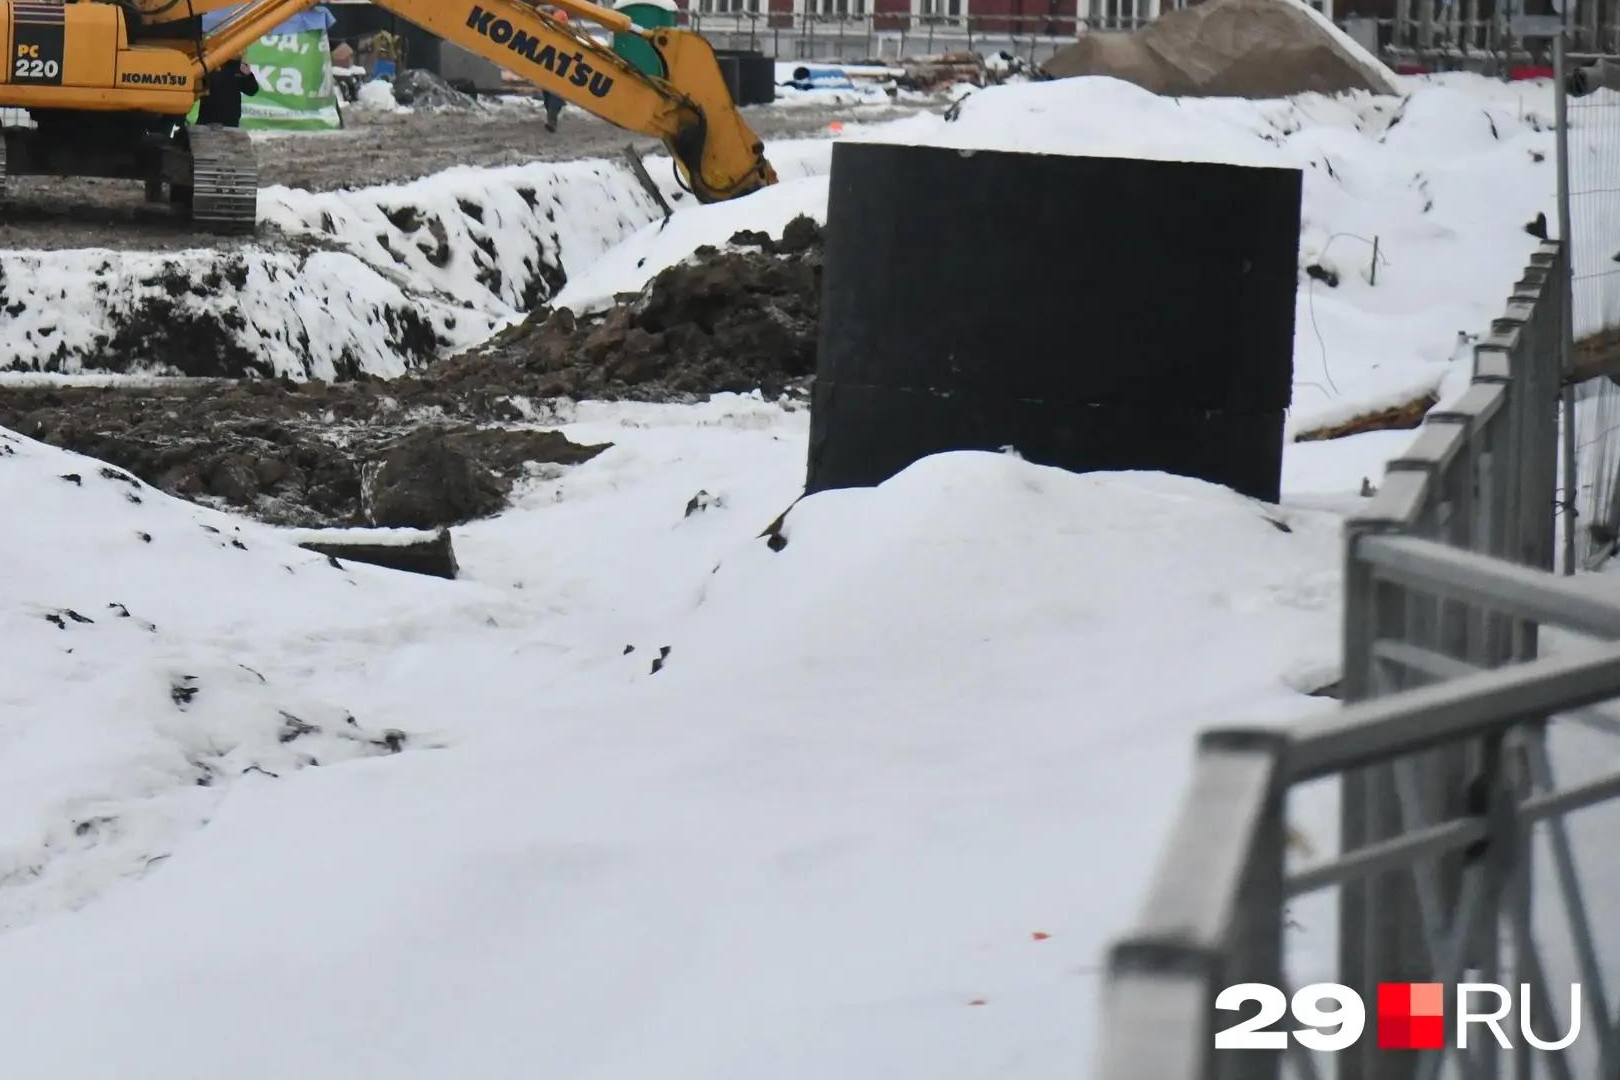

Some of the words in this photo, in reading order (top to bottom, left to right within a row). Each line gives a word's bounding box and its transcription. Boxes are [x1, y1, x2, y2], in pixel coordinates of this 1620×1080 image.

[18, 44, 39, 58] PC
[466, 5, 614, 97] KOMATSU
[15, 59, 59, 78] 220
[121, 72, 187, 86] KOMATSU
